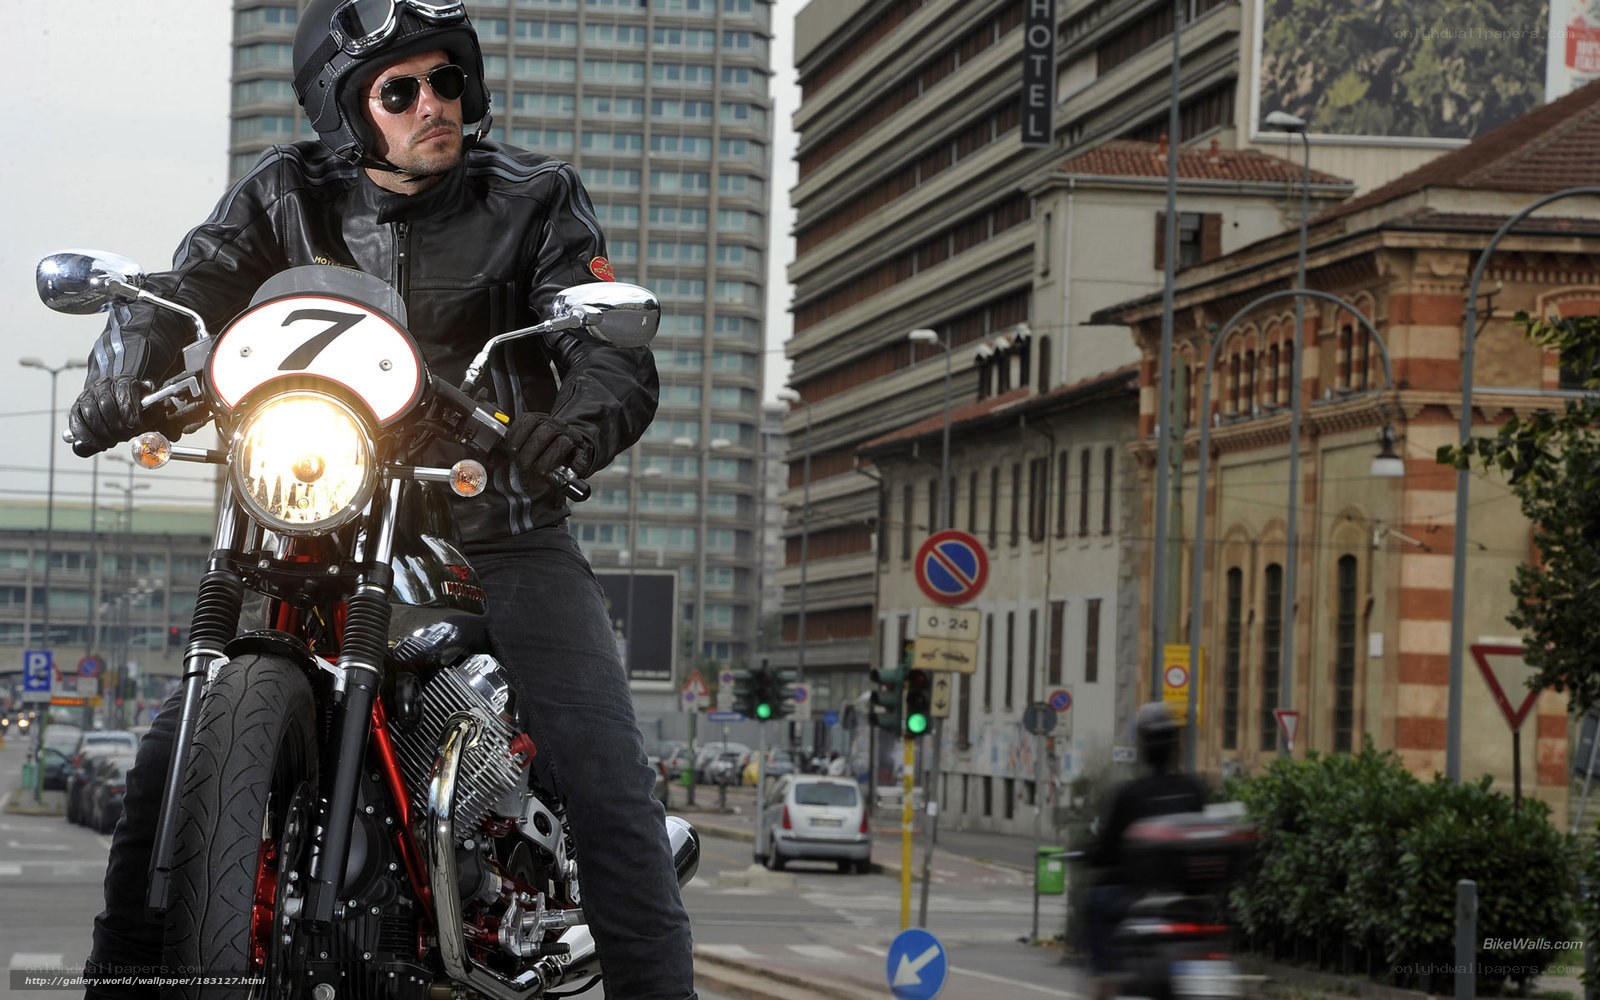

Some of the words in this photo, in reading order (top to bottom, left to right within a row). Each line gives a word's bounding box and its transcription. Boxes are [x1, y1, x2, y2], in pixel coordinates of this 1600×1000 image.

[1028, 0, 1051, 137] HOTEL
[278, 310, 367, 371] 7
[28, 653, 48, 677] P
